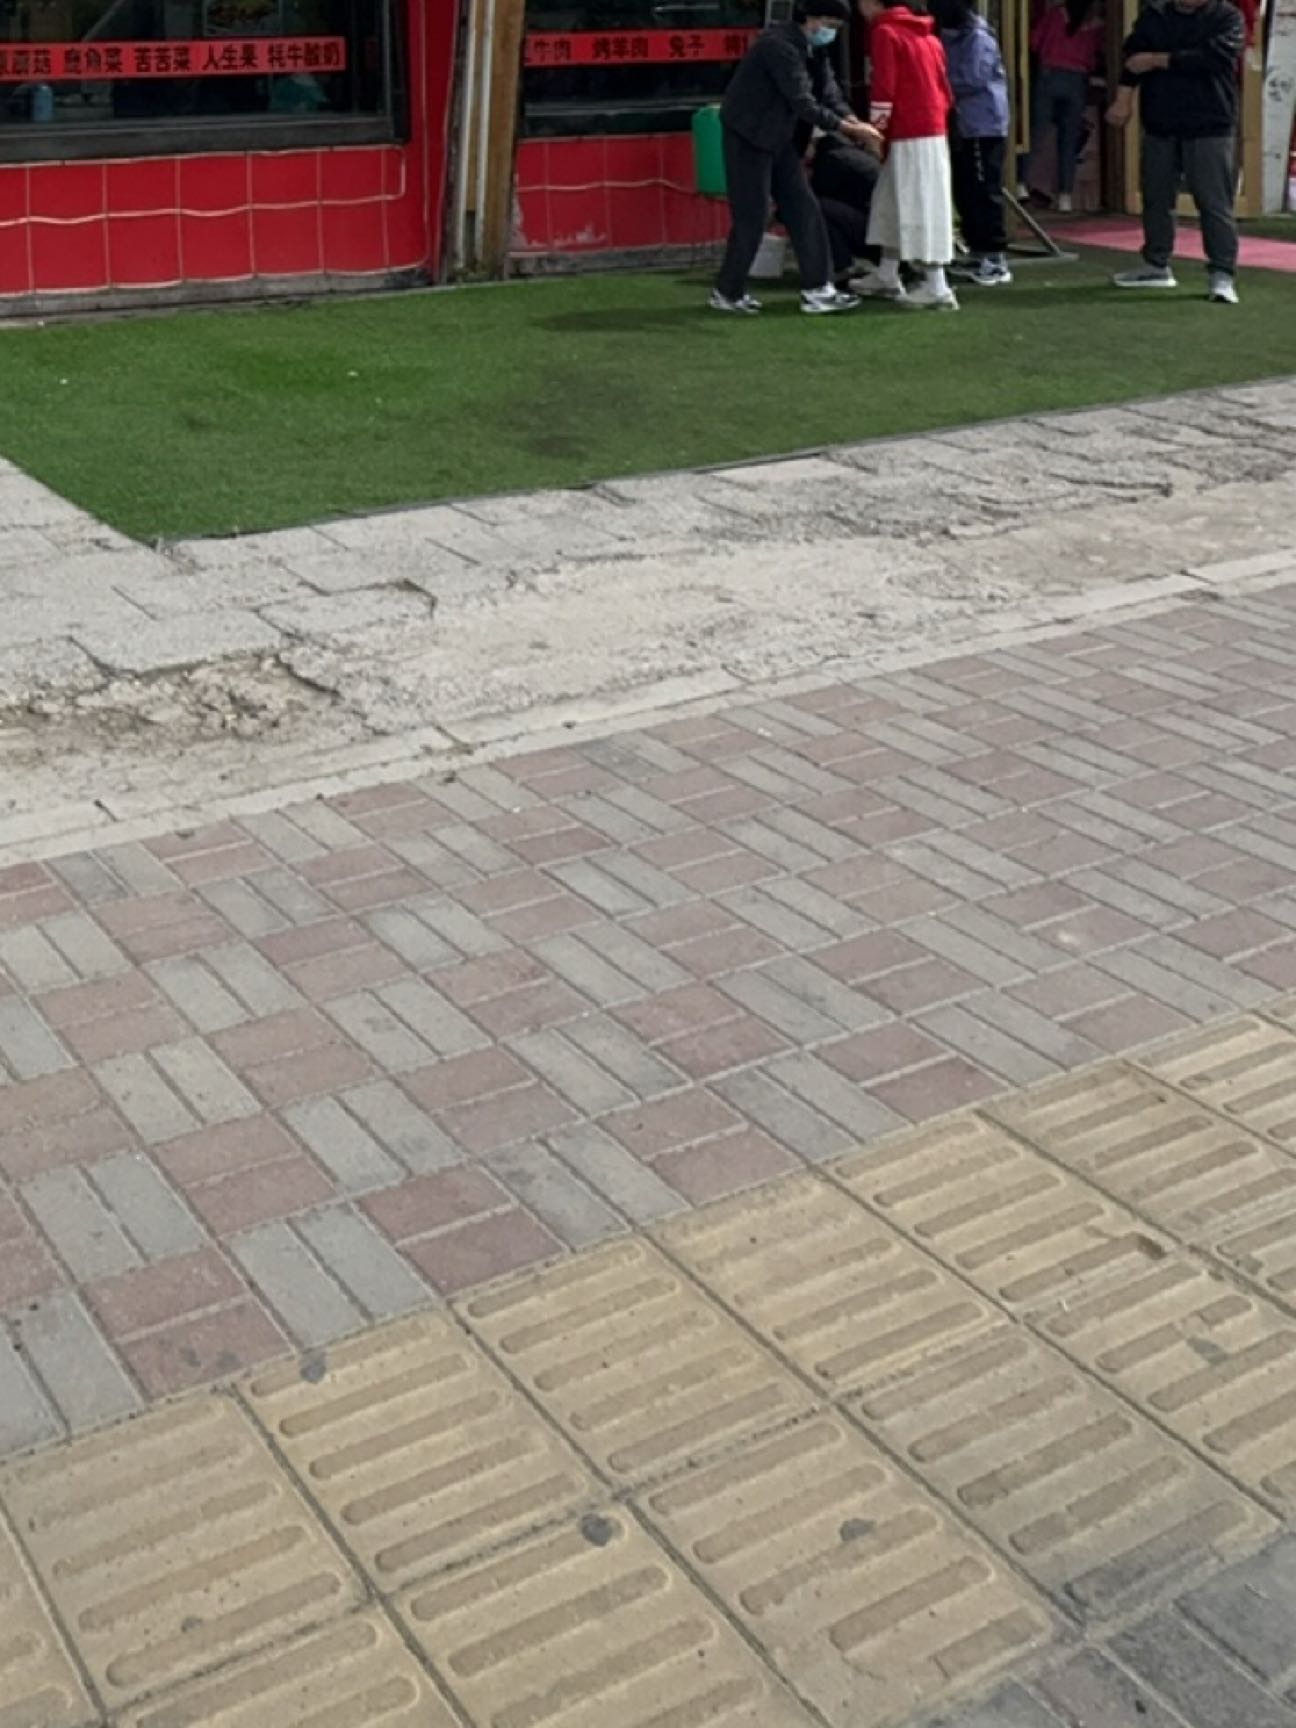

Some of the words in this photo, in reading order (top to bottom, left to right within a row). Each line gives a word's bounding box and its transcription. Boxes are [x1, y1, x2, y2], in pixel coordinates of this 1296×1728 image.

[203, 43, 259, 71] 人生果
[523, 37, 572, 62] 牛肉
